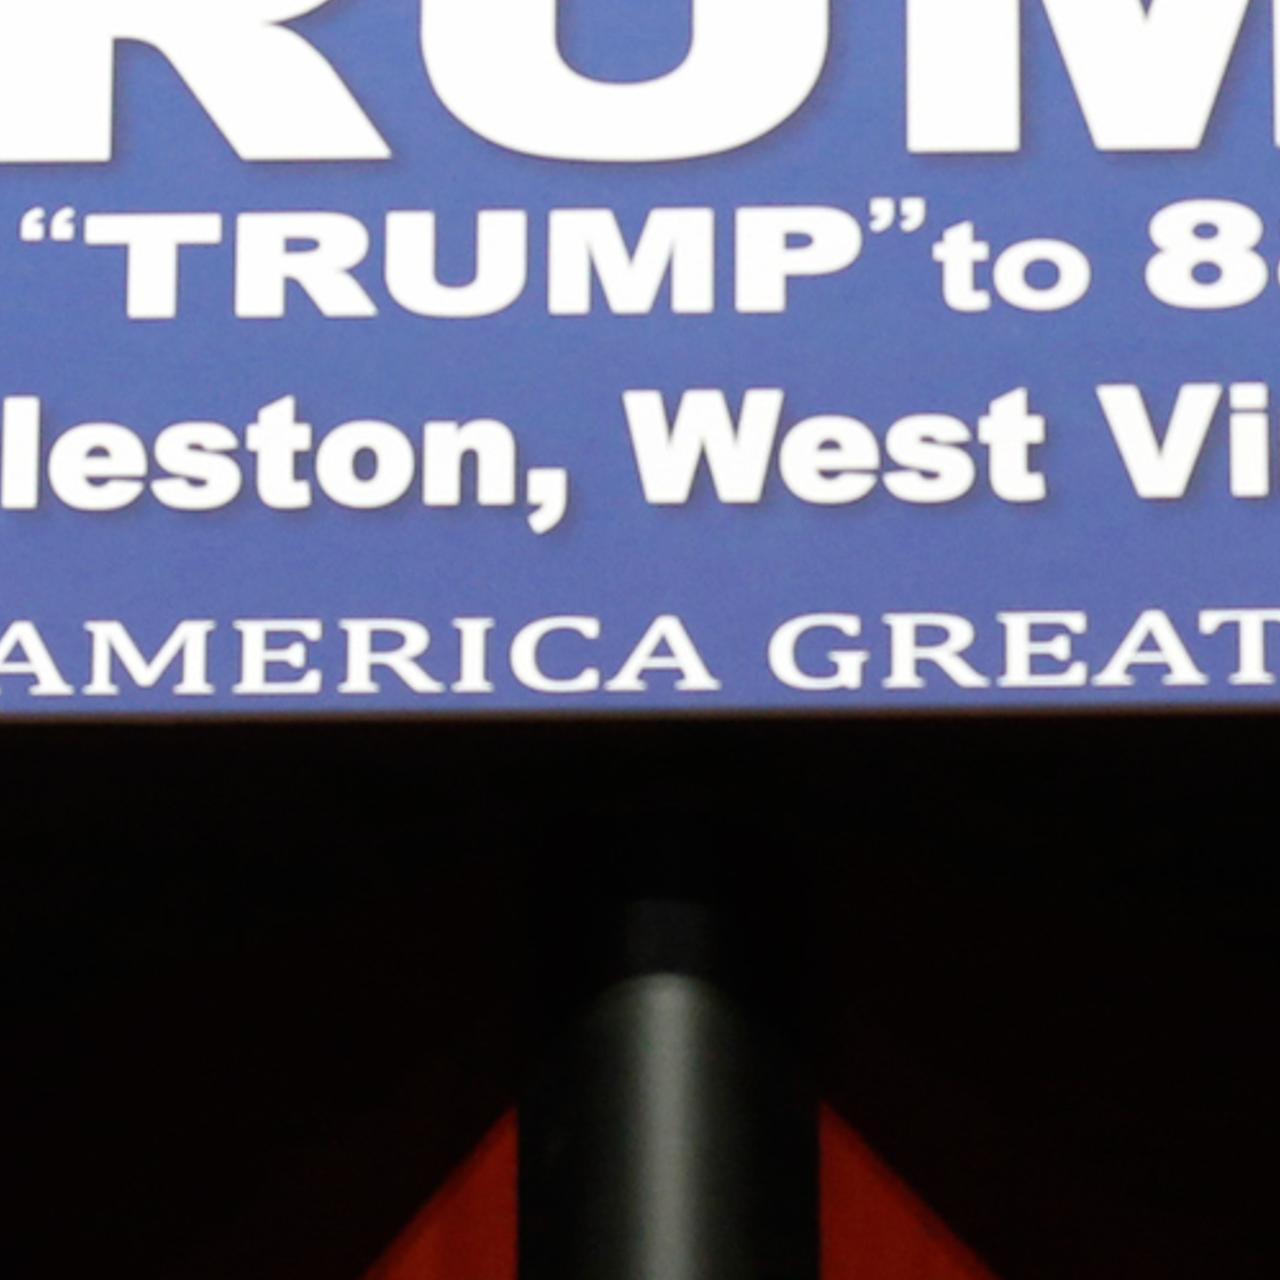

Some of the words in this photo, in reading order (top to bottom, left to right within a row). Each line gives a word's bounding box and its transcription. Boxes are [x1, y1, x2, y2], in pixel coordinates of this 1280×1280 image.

[20, 197, 926, 318] “TRUMP”
[932, 221, 1090, 312] to
[623, 385, 1045, 503] West
